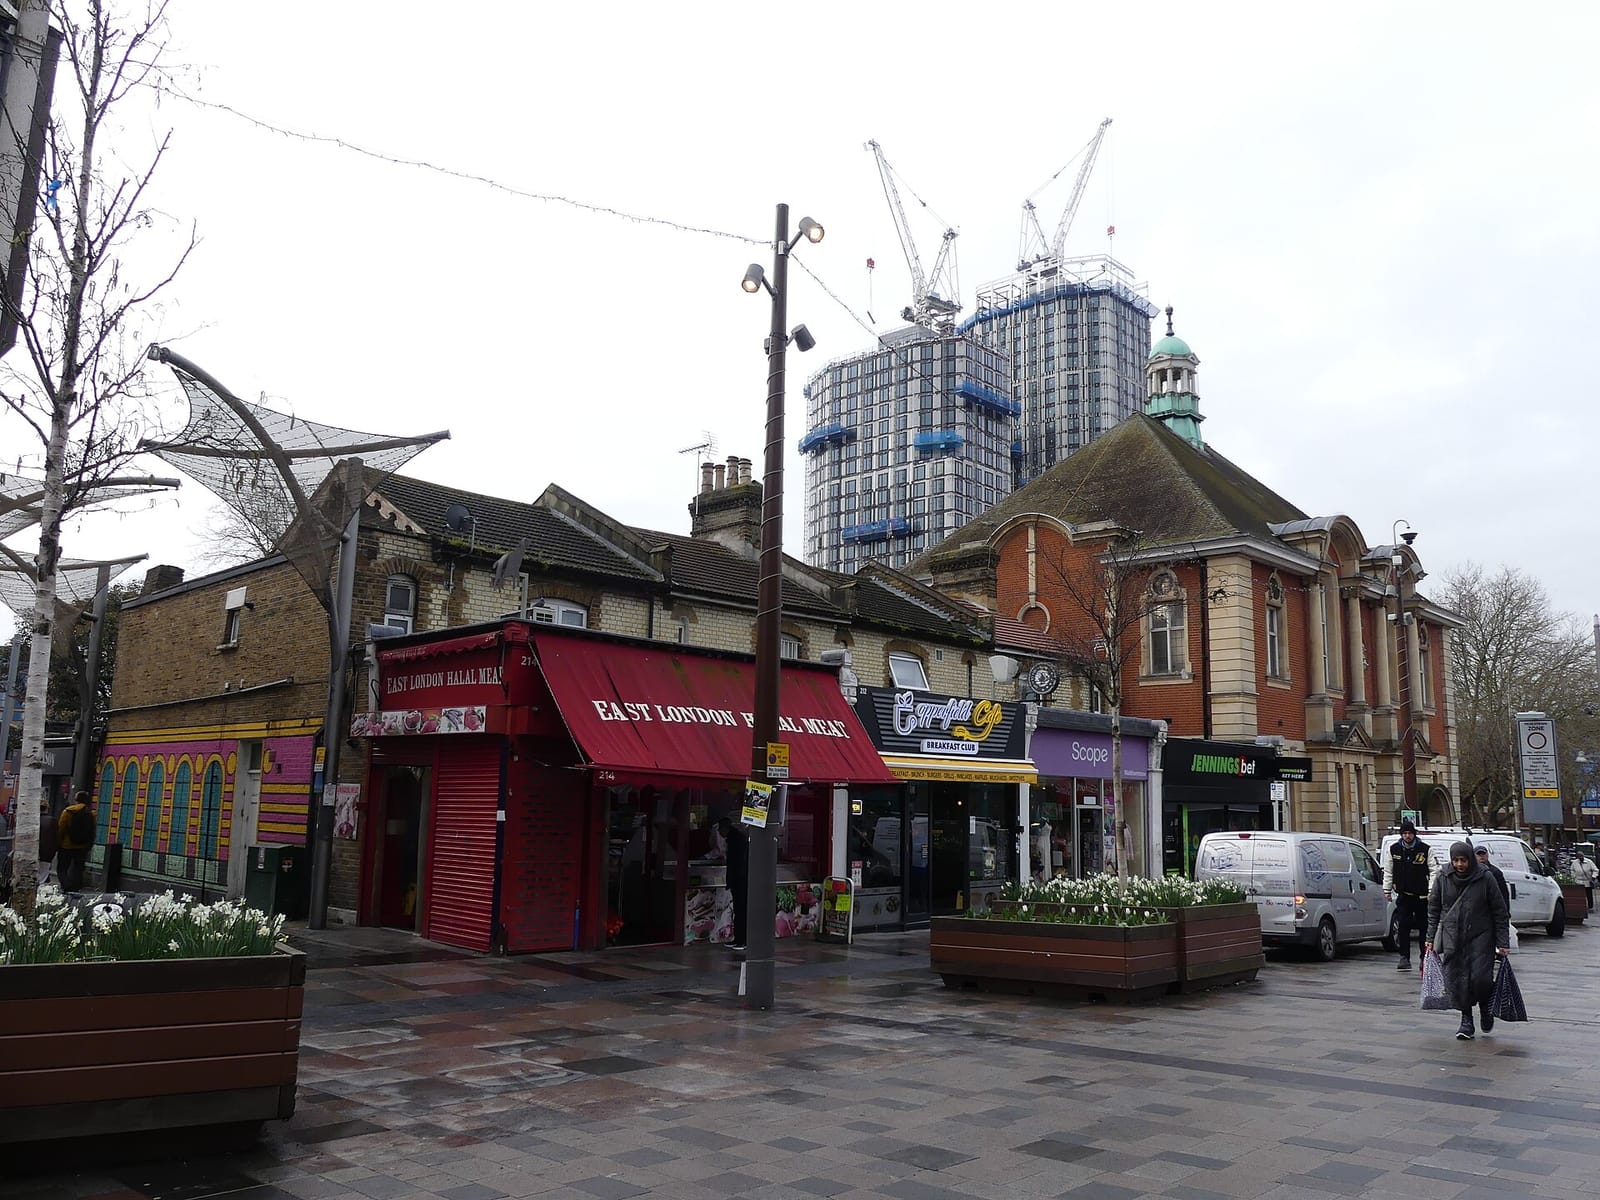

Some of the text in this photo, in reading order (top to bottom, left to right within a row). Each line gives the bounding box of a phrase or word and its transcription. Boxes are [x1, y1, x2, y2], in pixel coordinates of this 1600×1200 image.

[387, 675, 408, 694] EAST
[410, 669, 443, 690] LONDON
[447, 667, 477, 687] HALAL
[592, 700, 850, 739] EAST LONDON HAL MEAT
[926, 741, 975, 751] BREAKFAST CLUB
[1071, 741, 1108, 767] Scope
[600, 771, 615, 780] 214
